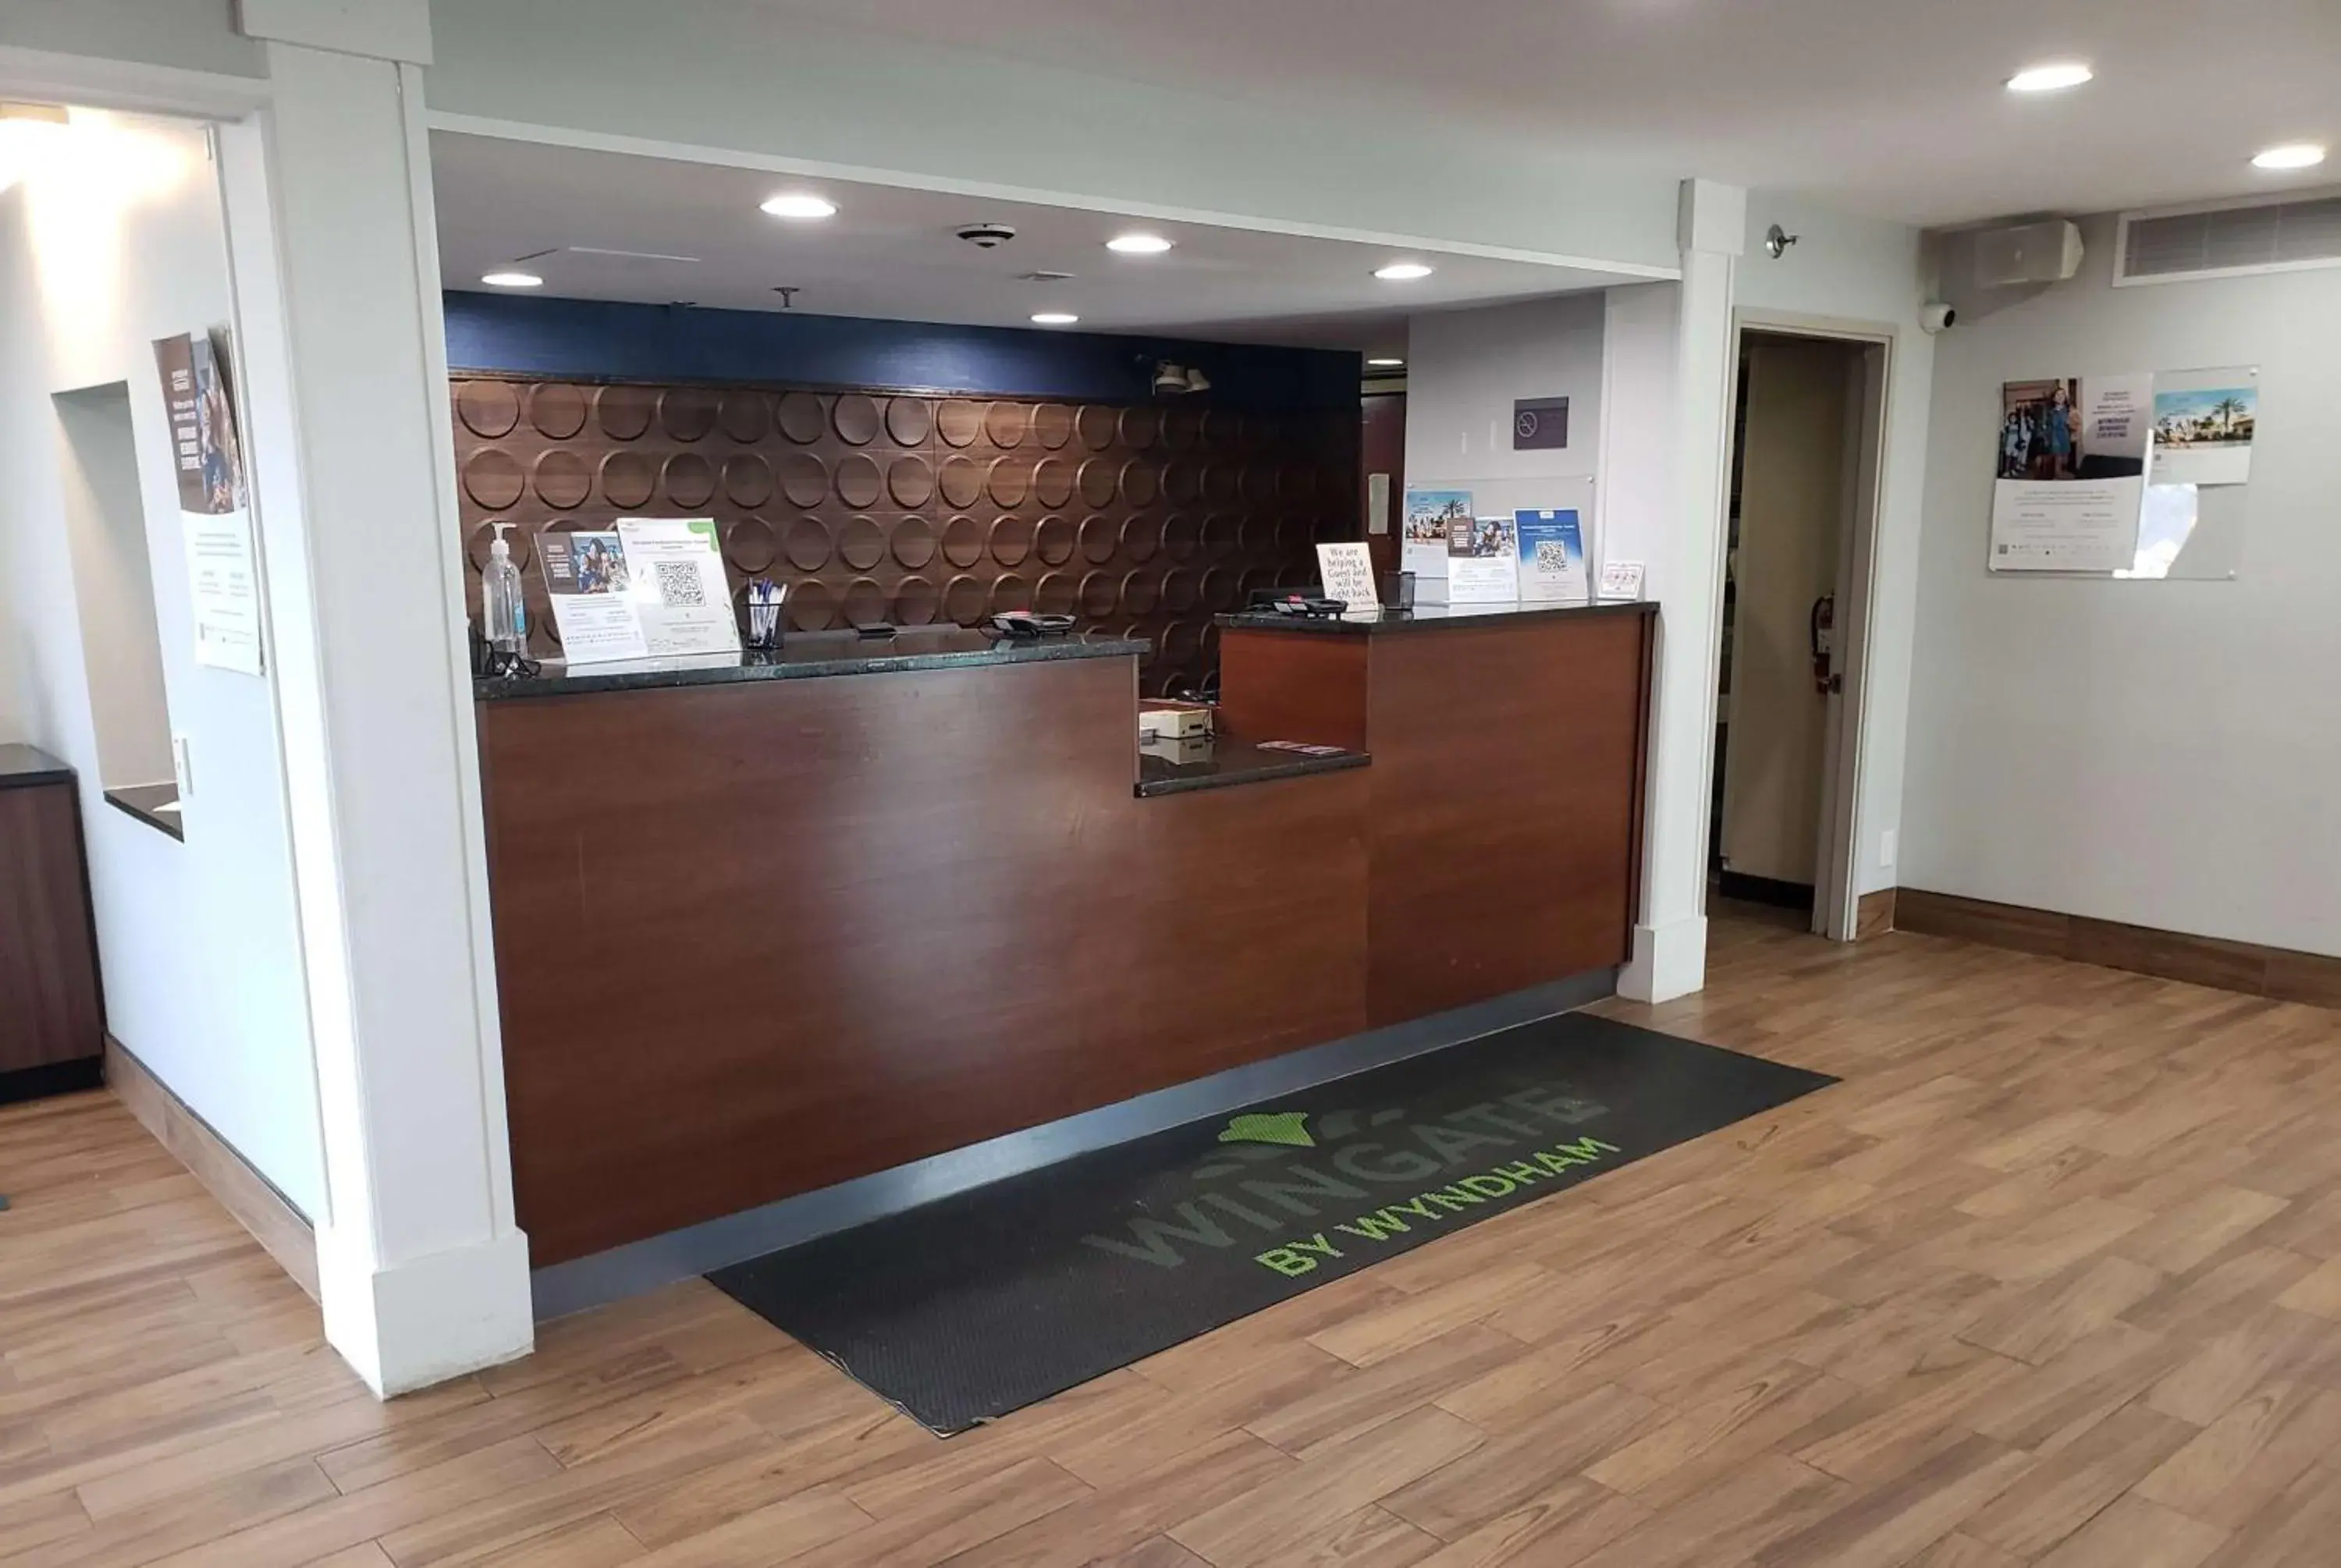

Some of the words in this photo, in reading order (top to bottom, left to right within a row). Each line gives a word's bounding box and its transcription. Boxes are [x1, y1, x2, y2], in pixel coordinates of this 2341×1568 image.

[1329, 548, 1343, 557] We
[1345, 548, 1359, 557] are
[1327, 557, 1357, 570] helping
[1352, 566, 1368, 576] and
[1335, 578, 1351, 587] will
[1352, 578, 1363, 587] be
[1081, 1083, 1611, 1268] WINGATE
[1255, 1233, 1345, 1278] BY
[1334, 1135, 1622, 1242] WYNDHAM
